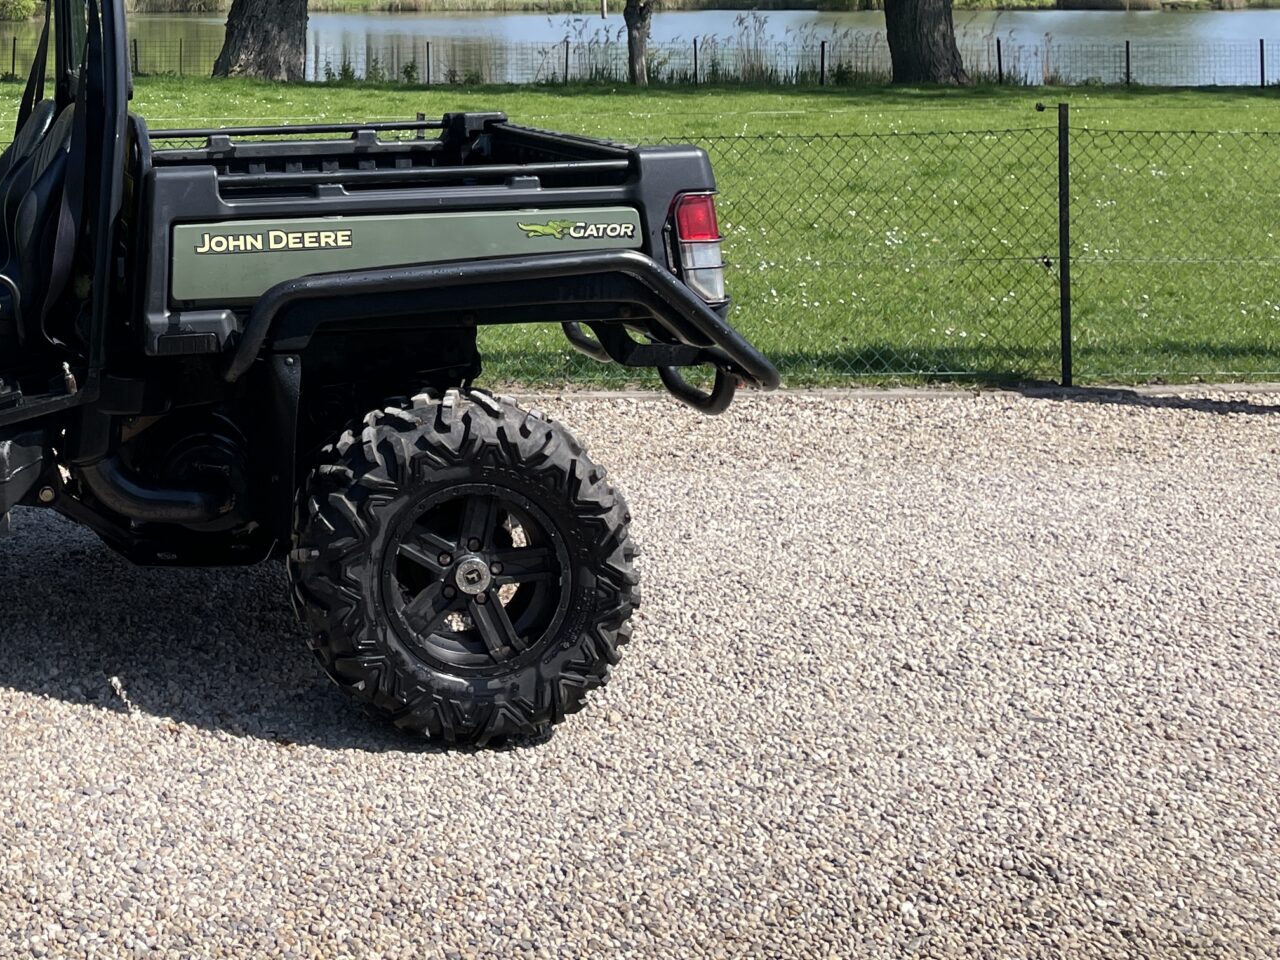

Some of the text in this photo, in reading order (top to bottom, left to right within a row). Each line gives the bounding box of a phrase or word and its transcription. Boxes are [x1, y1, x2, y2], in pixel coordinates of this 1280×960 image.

[569, 222, 634, 238] GATOR
[196, 230, 352, 253] JOHN DEERE
